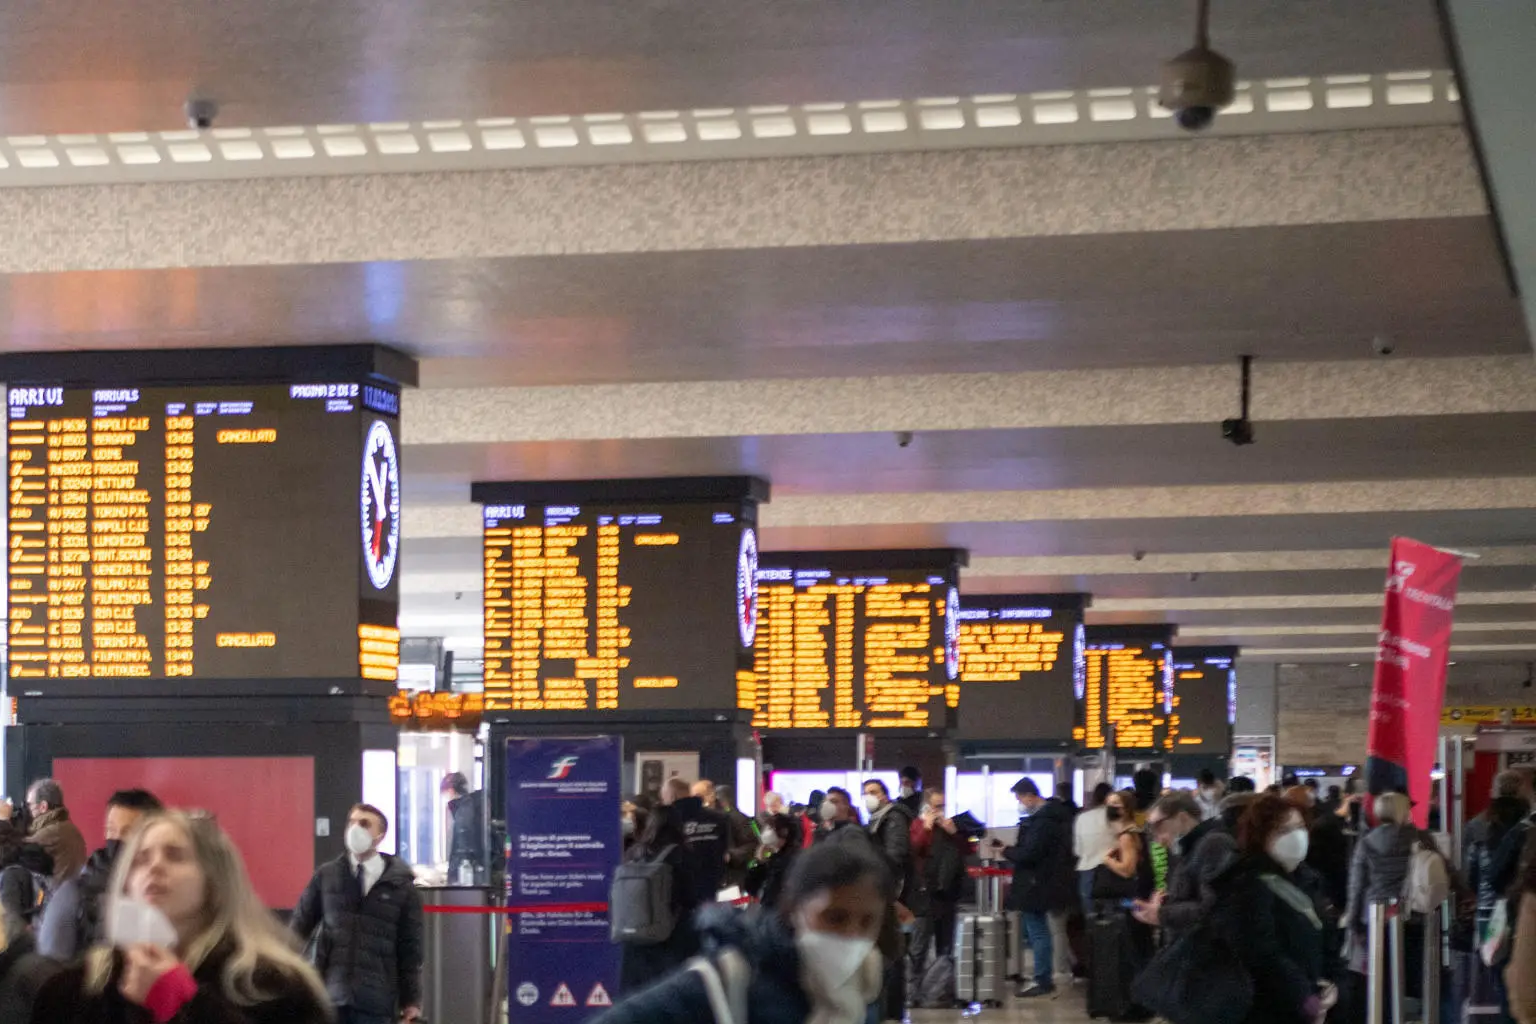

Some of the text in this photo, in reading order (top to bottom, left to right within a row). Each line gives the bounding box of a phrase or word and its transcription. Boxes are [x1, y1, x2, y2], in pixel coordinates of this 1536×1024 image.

[10, 387, 140, 405] ARRIVI ARRIVALS
[328, 385, 337, 398] 2
[349, 384, 359, 397] 2
[217, 429, 277, 443] CANCELLATO
[485, 506, 525, 518] ARRIVI
[216, 632, 275, 647] CANCELLATO
